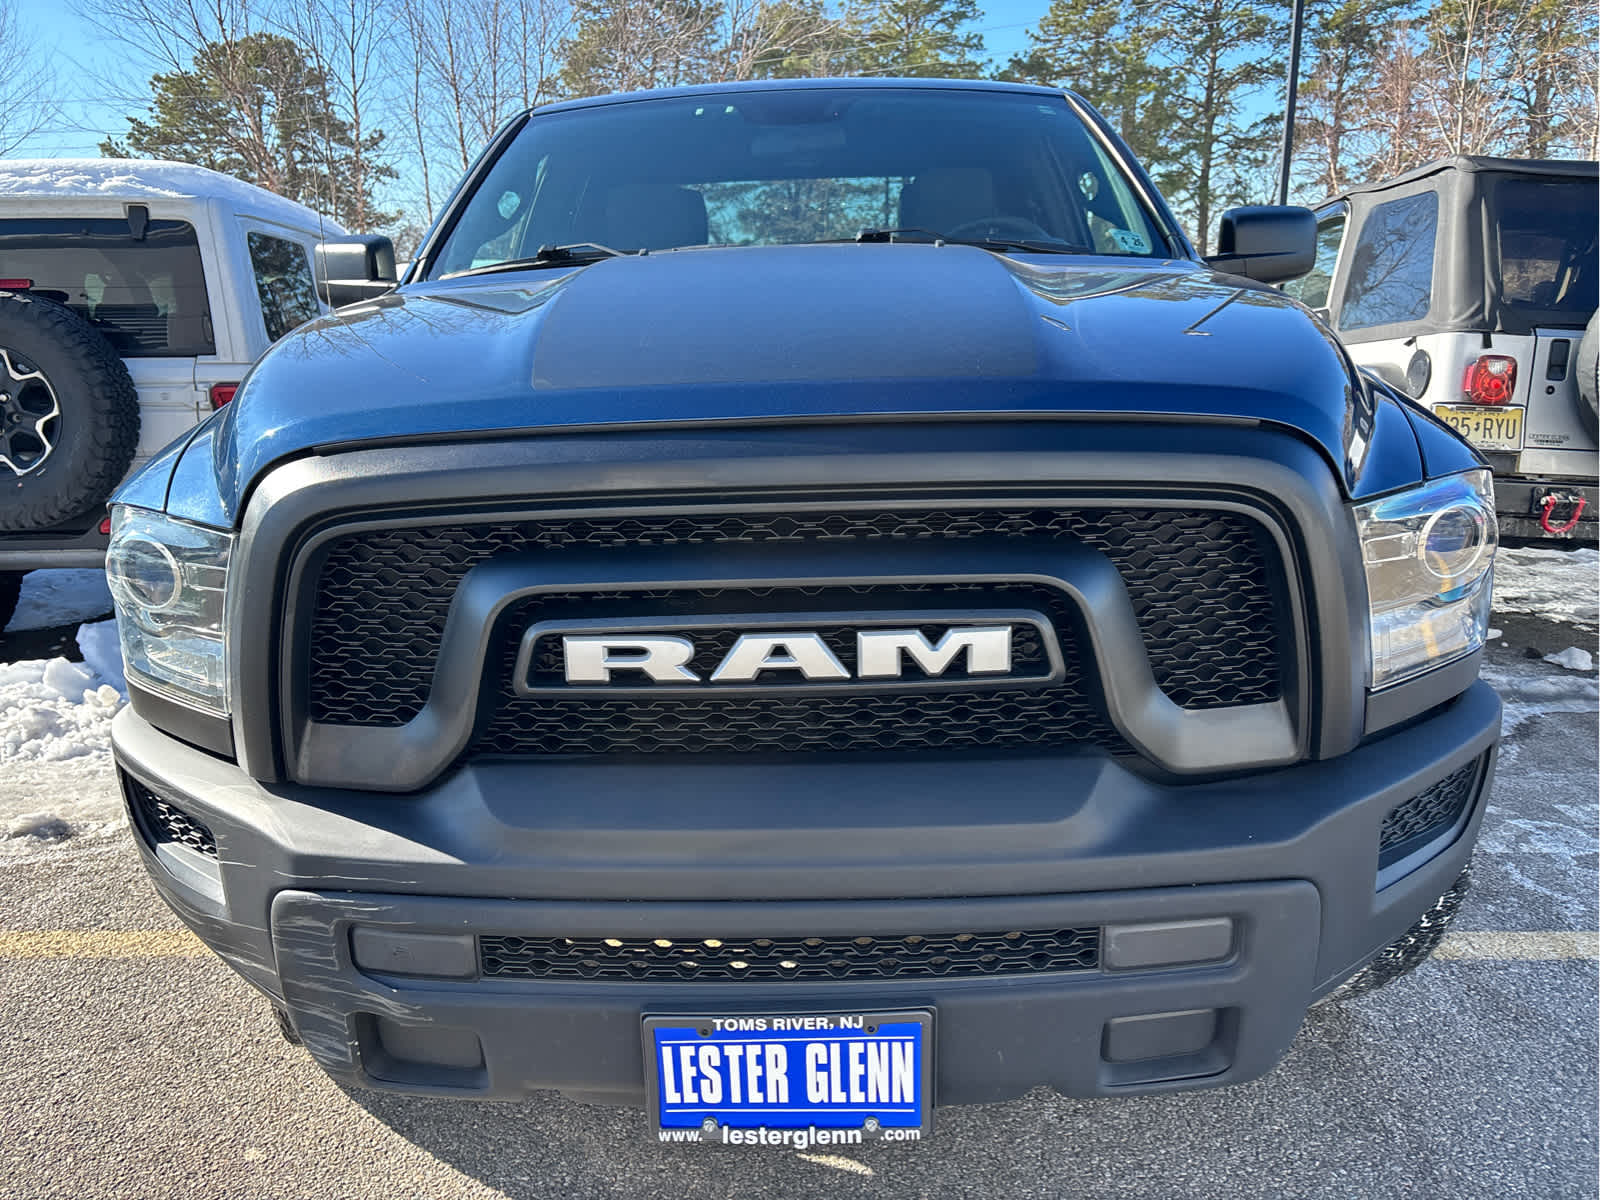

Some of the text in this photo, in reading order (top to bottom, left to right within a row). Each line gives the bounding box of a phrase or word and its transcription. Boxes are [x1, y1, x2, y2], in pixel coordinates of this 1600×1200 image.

[1438, 415, 1517, 440] 35 RYU
[562, 625, 1012, 683] RAM
[712, 1016, 864, 1032] TOMS RIVER, NJ
[661, 1041, 914, 1104] LESTER GLENN
[658, 1125, 921, 1149] www. lesterglenn .com
